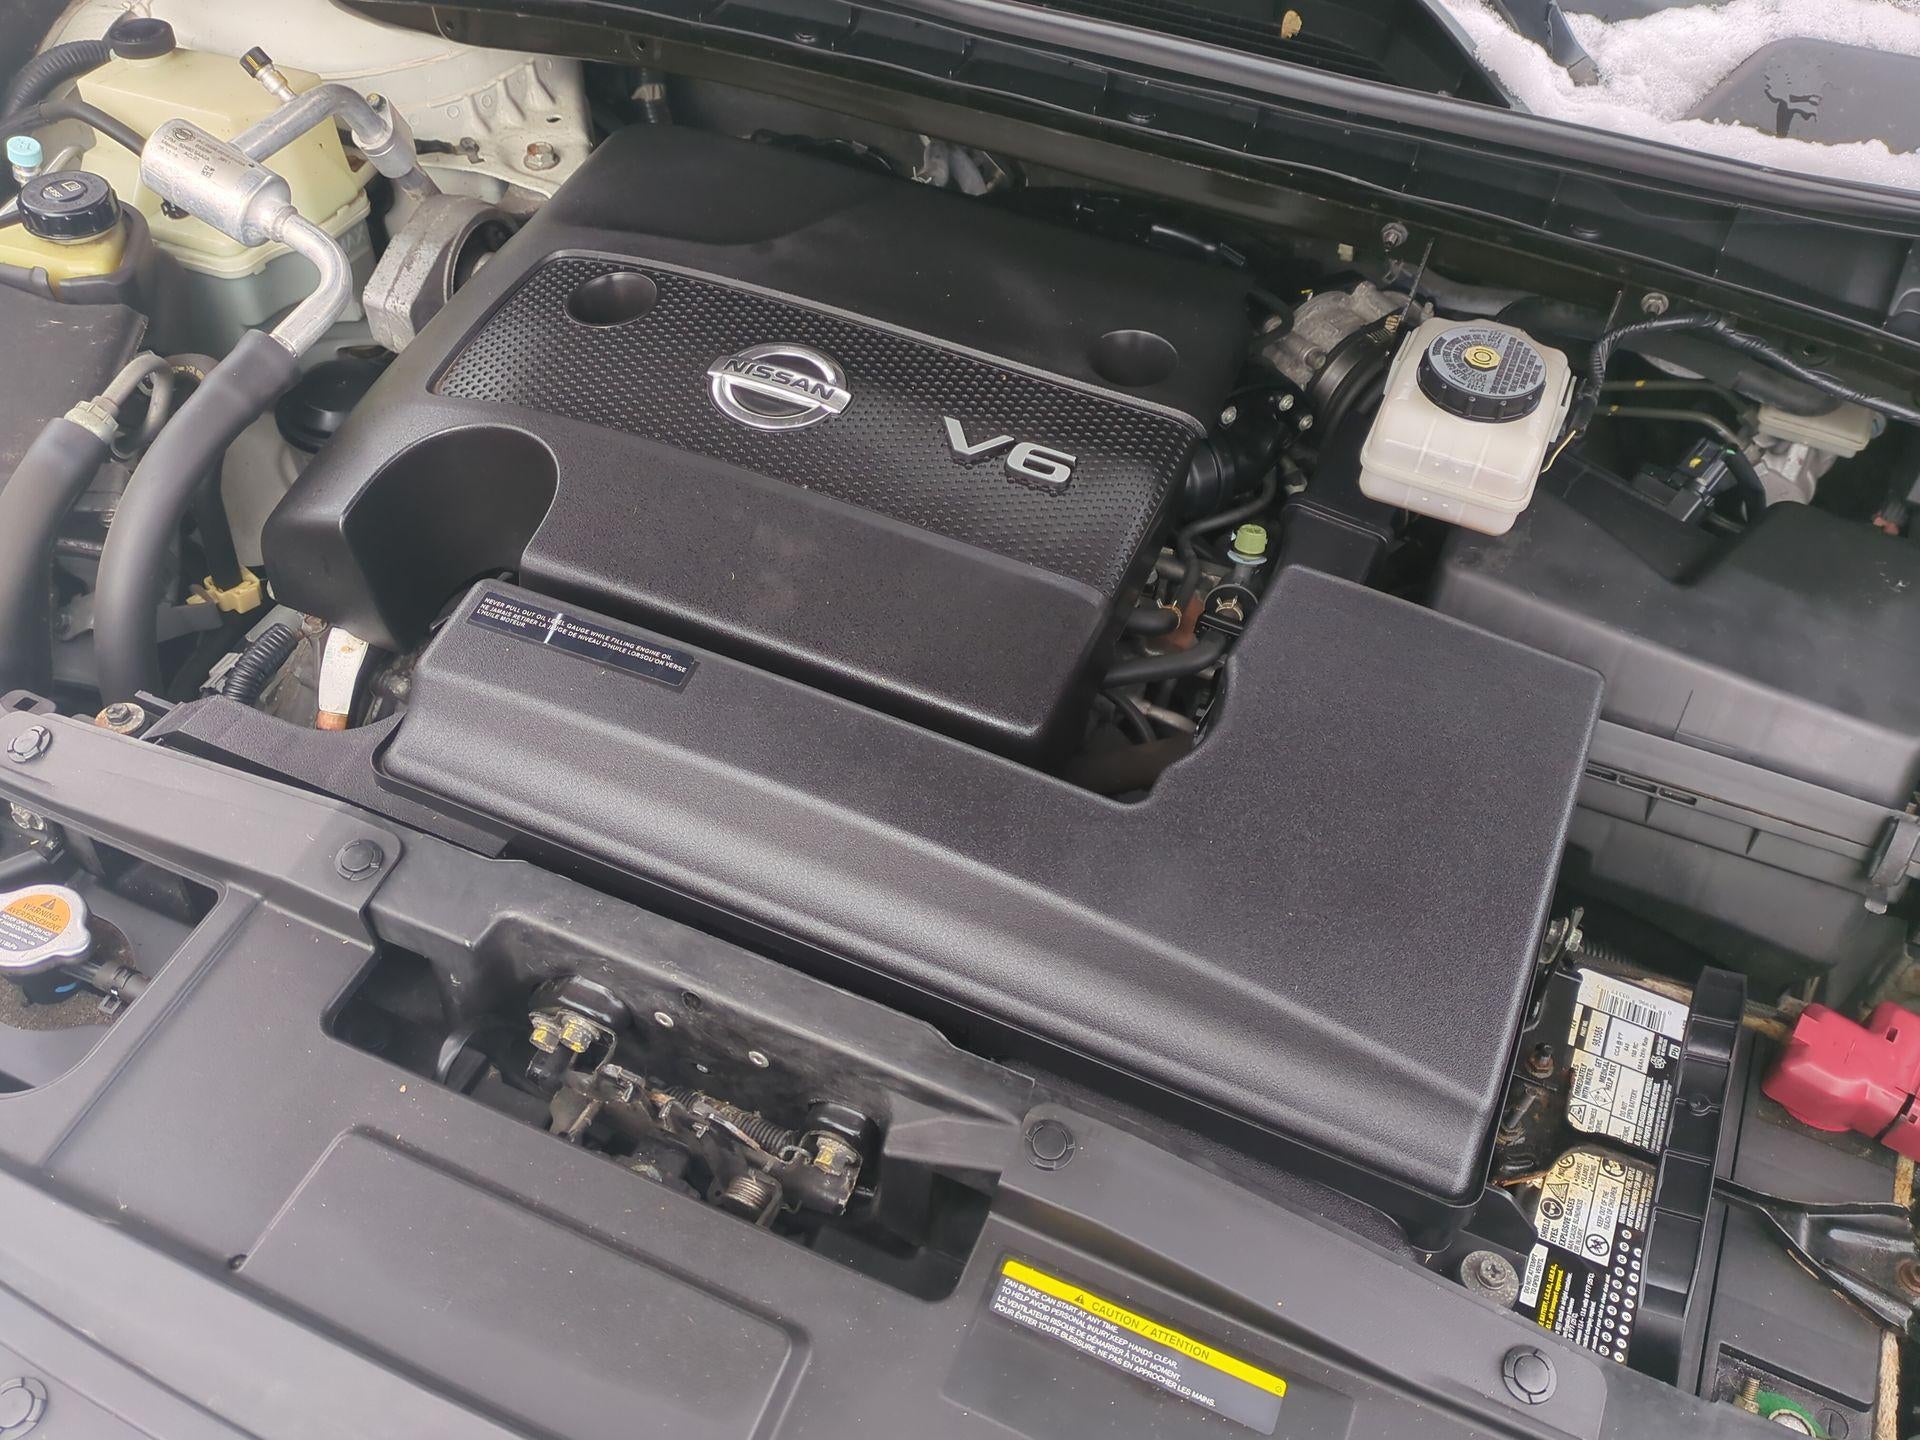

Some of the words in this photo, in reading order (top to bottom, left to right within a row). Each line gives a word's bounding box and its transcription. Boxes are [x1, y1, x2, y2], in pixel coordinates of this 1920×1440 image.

[722, 358, 835, 400] NISSAN
[943, 415, 1079, 485] V6
[477, 609, 499, 620] L'HUILE
[485, 597, 504, 609] NEVER
[506, 604, 520, 615] PULL
[522, 608, 536, 619] OUT
[536, 613, 546, 621] OIL
[548, 616, 565, 627] LEEL
[566, 623, 590, 636] GAUGE
[590, 630, 610, 642] WHILE
[610, 637, 636, 650] FILLING
[636, 645, 660, 658] ENGINE
[490, 606, 512, 618] JAMAIS
[512, 614, 538, 626] RETIRER
[578, 634, 601, 646] NIVEAU
[602, 642, 627, 654] D'HUILE
[627, 650, 664, 666] LORSQU'ON
[666, 662, 688, 673] VERSE
[1599, 1060, 1609, 1083] MEDICAL
[1671, 1046, 1679, 1057] Pb
[1574, 1062, 1586, 1096] IMMEDIATELY
[1581, 1164, 1589, 1182] FLAMES
[1540, 1218, 1550, 1239] SHIELD
[1559, 1215, 1570, 1246] EXPLOSIVE
[1565, 1197, 1575, 1216] GASES
[1569, 1224, 1577, 1240] CAUSE
[1528, 1253, 1537, 1276] ATTEMPT
[1001, 1286, 1012, 1296] TO
[1011, 1290, 1030, 1304] HELP
[1029, 1298, 1050, 1312] AVOID
[1050, 1308, 1087, 1329] PERSONAL
[1128, 1342, 1154, 1358] HANDS
[1153, 1353, 1178, 1369] CLEAR.
[1004, 1278, 1018, 1289] FAN
[1019, 1284, 1042, 1299] BLADE
[1040, 1292, 1056, 1305] CAN
[1056, 1298, 1080, 1314] START
[1078, 1308, 1088, 1318] AT
[1087, 1311, 1102, 1325] ANY
[1102, 1318, 1119, 1334] TIME.
[998, 1294, 1007, 1304] LE
[1006, 1298, 1050, 1322] VENTILATEUR
[1050, 1316, 1077, 1334] RISQUE
[1076, 1328, 1088, 1340] DE
[1086, 1332, 1124, 1356] DÉMARRER
[1124, 1350, 1131, 1358] À
[1130, 1354, 1150, 1367] TOUT
[1091, 1301, 1140, 1329] CAUTION
[1150, 1328, 1210, 1360] ATTENTION
[994, 1302, 1014, 1317] POUR
[1014, 1310, 1039, 1326] ÉVITER
[1038, 1322, 1060, 1336] TOUTE
[1097, 1349, 1108, 1360] NE
[1108, 1354, 1122, 1366] PAS
[1122, 1360, 1134, 1371] EN
[1133, 1364, 1178, 1391] APPROCHER
[1177, 1384, 1192, 1396] LES
[1191, 1390, 1216, 1408] MAINS.
